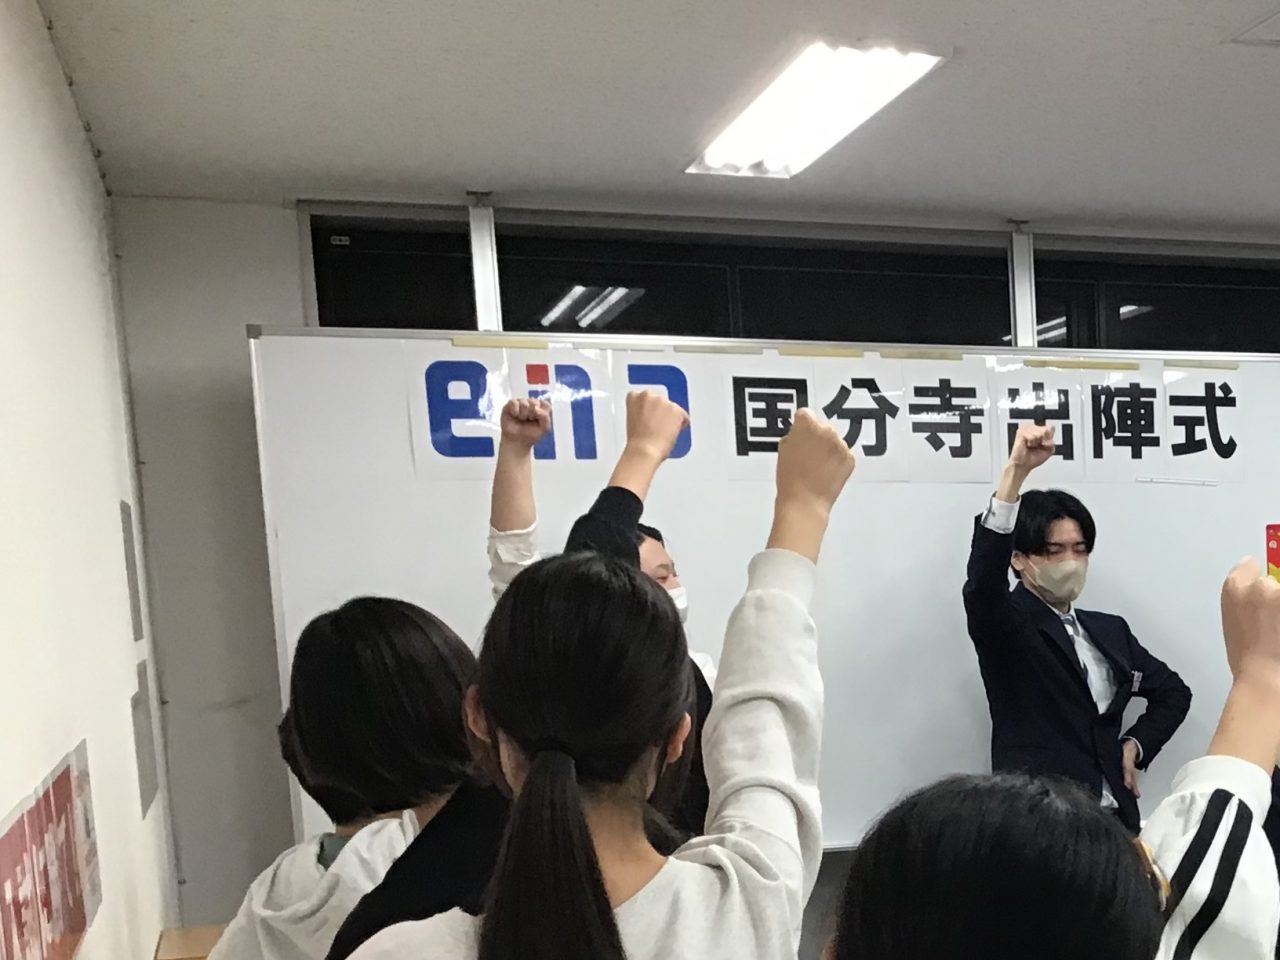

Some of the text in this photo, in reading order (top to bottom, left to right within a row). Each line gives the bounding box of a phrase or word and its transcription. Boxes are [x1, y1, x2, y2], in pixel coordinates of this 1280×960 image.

[732, 376, 1238, 461] 国分寺出陣式
